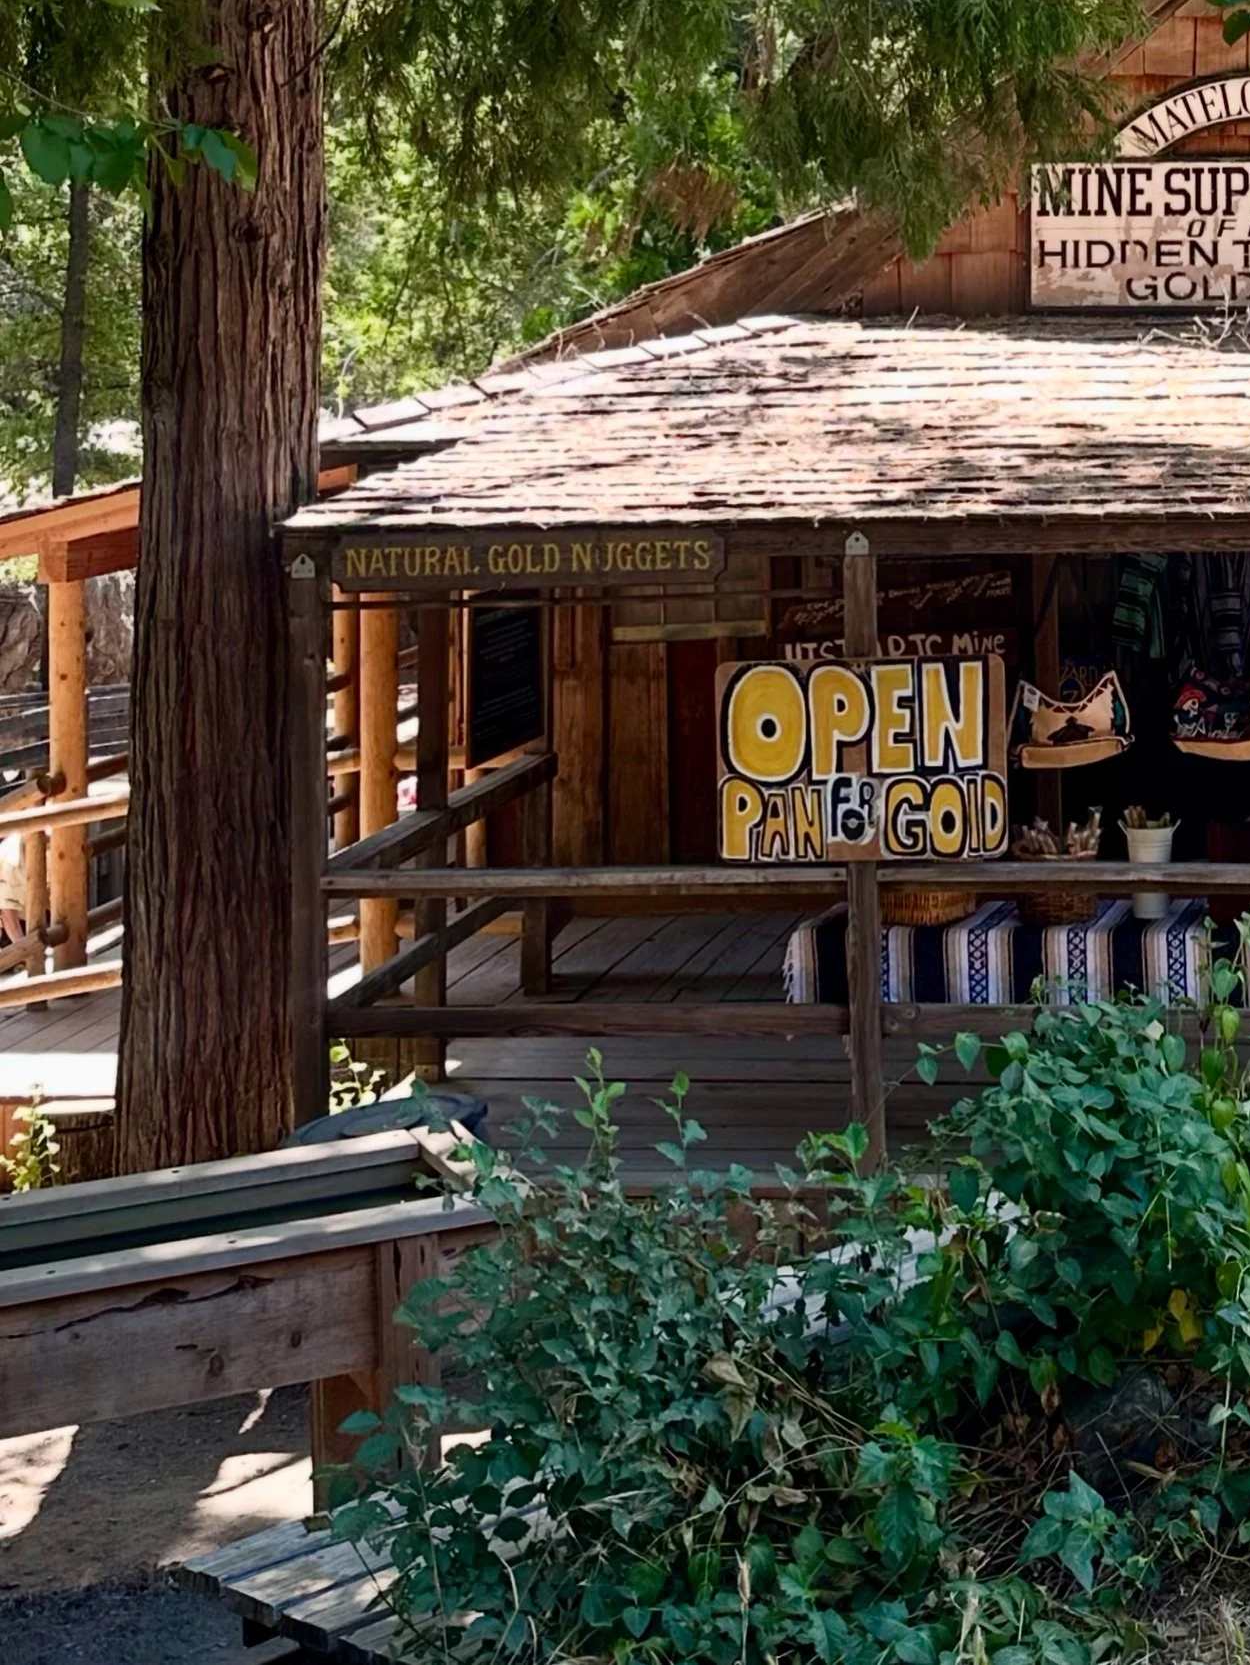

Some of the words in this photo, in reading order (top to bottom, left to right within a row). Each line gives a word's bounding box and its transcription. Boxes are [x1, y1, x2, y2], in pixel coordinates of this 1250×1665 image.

[1036, 167, 1153, 216] MINE
[1037, 240, 1219, 269] HIDDEN
[345, 545, 480, 578] NATURAL
[487, 542, 560, 575] GOLD
[726, 661, 984, 782] OPEN
[721, 777, 826, 861] PAN
